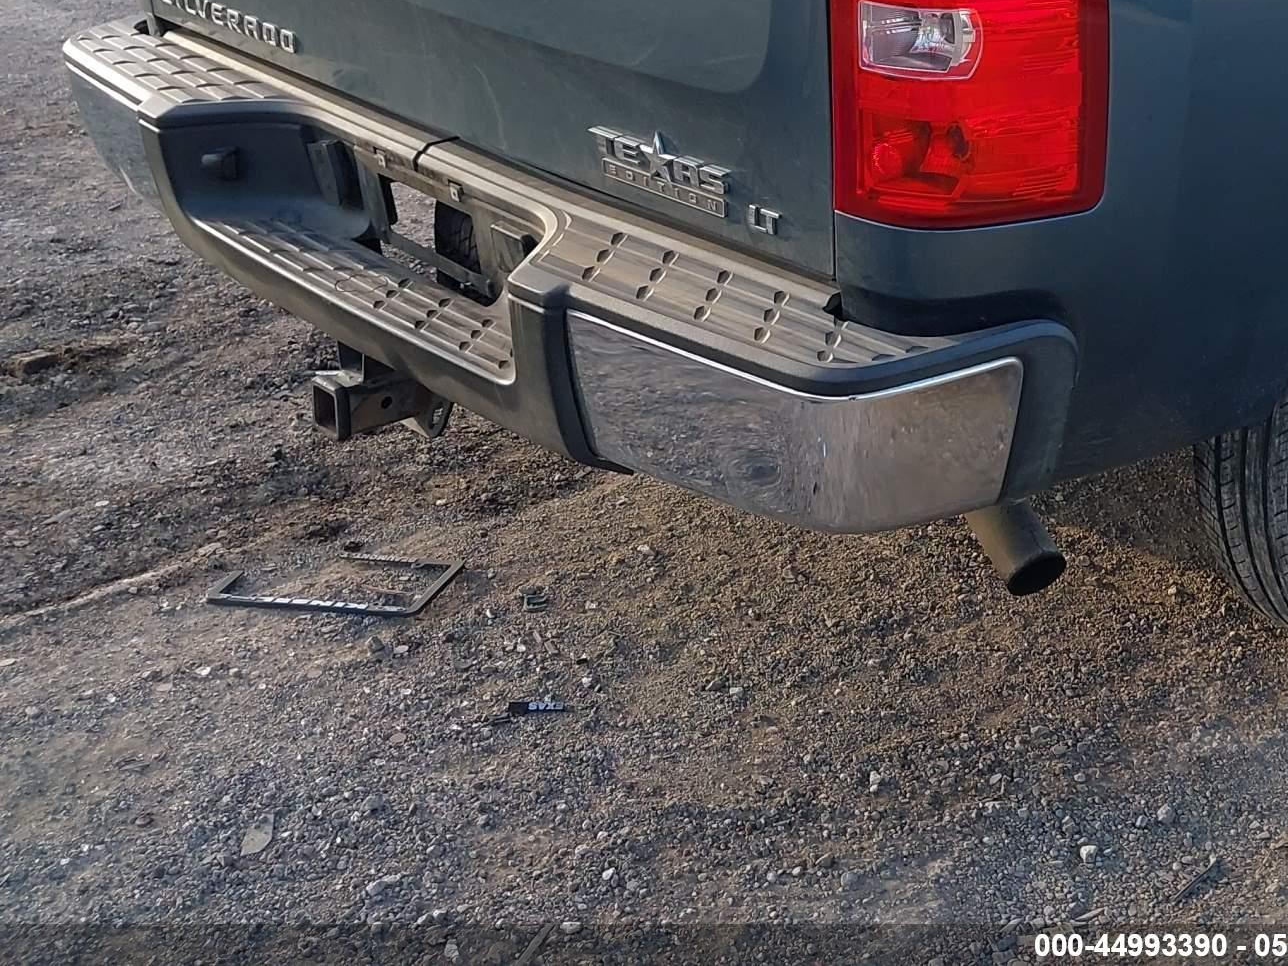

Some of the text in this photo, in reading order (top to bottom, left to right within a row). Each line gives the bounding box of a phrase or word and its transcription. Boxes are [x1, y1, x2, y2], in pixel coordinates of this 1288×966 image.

[588, 126, 731, 194] TEXAS
[608, 163, 719, 212] EDITION
[747, 203, 783, 235] LT
